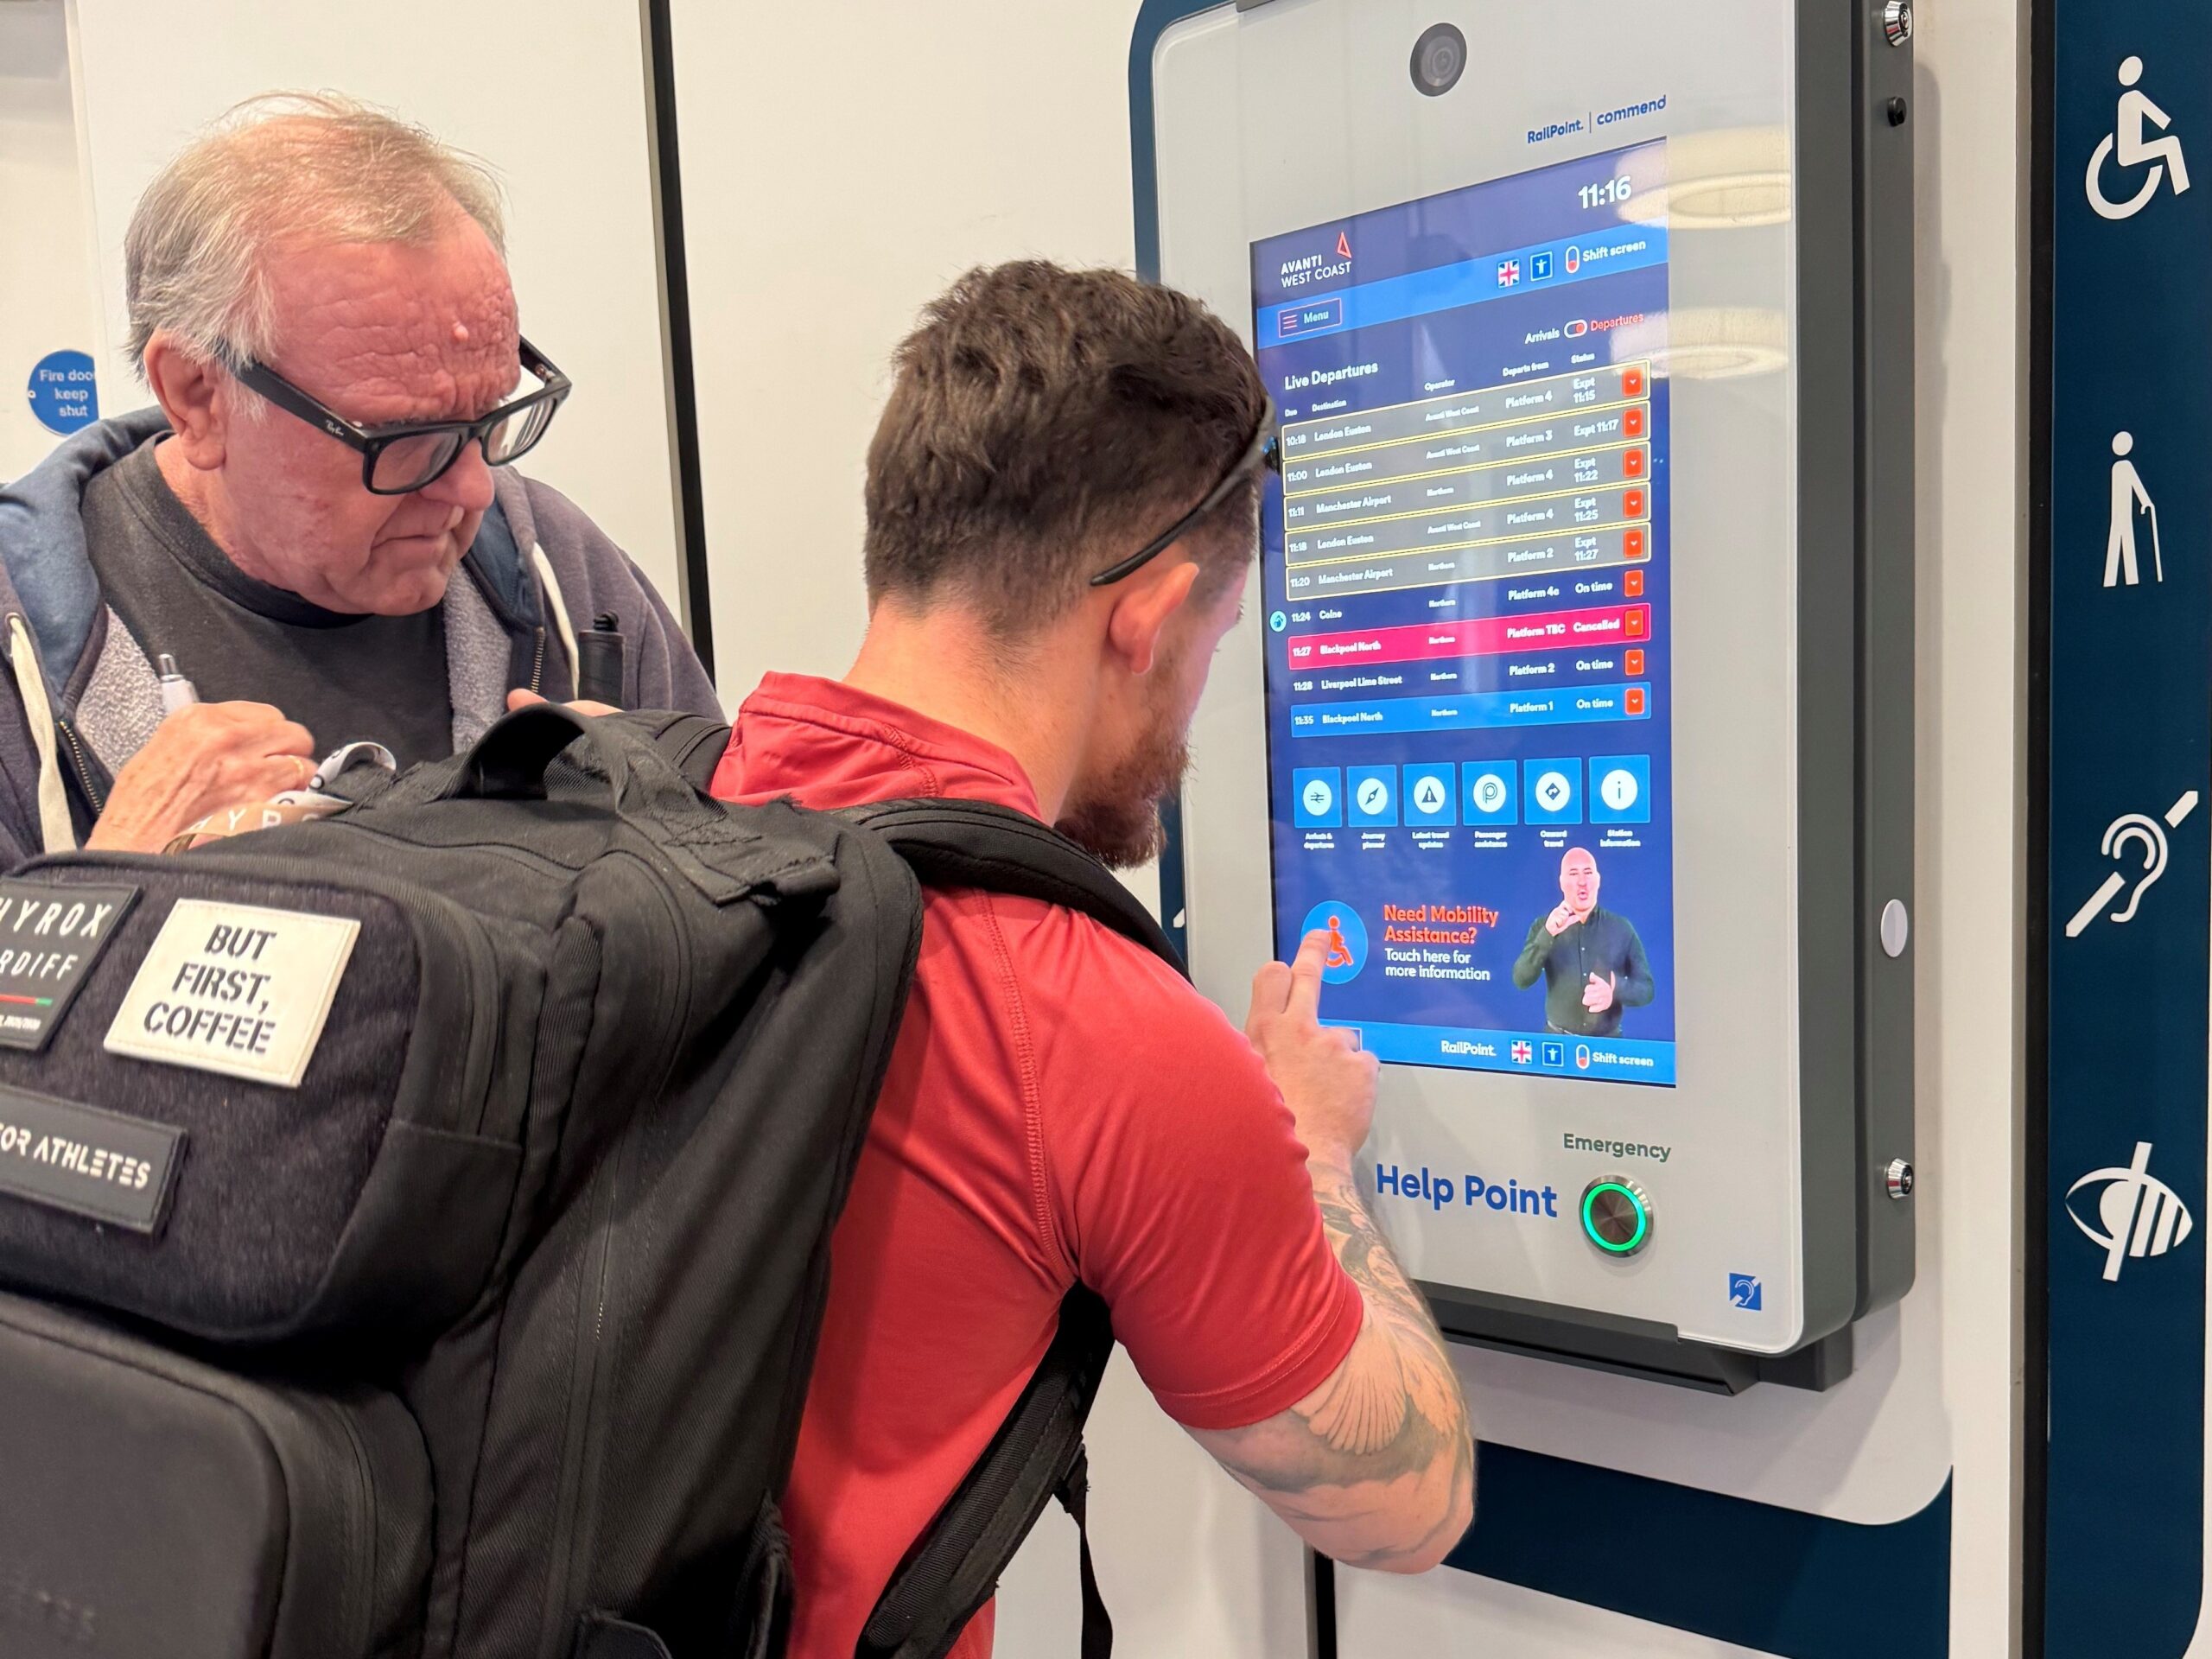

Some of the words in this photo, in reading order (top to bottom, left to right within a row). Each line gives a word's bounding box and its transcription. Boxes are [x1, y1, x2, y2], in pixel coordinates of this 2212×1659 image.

[1597, 94, 1667, 125] commend
[1578, 175, 1631, 209] 11:16
[1582, 247, 1608, 262] Shift
[1610, 240, 1646, 257] screen
[1281, 254, 1322, 275] AVANTI
[1281, 271, 1311, 288] WEST
[1314, 261, 1351, 280] COAST
[1303, 310, 1329, 324] Menu
[1591, 313, 1644, 332] Departures
[1524, 327, 1560, 345] Arrivals
[1571, 353, 1595, 364] Status
[40, 369, 65, 381] Fire
[68, 369, 94, 381] doo
[1285, 375, 1310, 391] Live
[1312, 363, 1379, 385] Departures
[1424, 379, 1455, 392] Operator
[1573, 377, 1596, 390] Expt
[54, 388, 88, 401] keep
[1505, 393, 1544, 409] Platform
[1545, 390, 1553, 402] 4
[1573, 390, 1596, 404] 11:15
[59, 404, 88, 416] shut
[1312, 399, 1347, 412] Destination
[1314, 429, 1344, 442] London
[1344, 425, 1371, 437] Euston
[1573, 424, 1597, 437] Expt
[1597, 418, 1619, 433] 11:17
[1286, 434, 1307, 447] 10:18
[1506, 433, 1545, 448] Platform
[1545, 429, 1553, 442] 3
[1315, 466, 1344, 478] London
[1345, 461, 1373, 474] Euston
[1574, 457, 1596, 470] Expt
[1287, 470, 1307, 482] 11:00
[1506, 474, 1545, 486] Platform
[1545, 469, 1554, 480] 4
[1573, 470, 1599, 483] 11:22
[1316, 499, 1362, 514] Manchester
[1363, 494, 1392, 508] Airport
[1574, 497, 1597, 510] Expt
[1288, 506, 1305, 518] 11:11
[1507, 512, 1546, 524] Platform
[1546, 508, 1554, 519] 4
[1574, 509, 1599, 523] 11:25
[1289, 541, 1307, 553] 11:18
[1317, 537, 1346, 550] London
[1347, 534, 1374, 546] Euston
[1574, 537, 1597, 550] Expt
[1507, 550, 1546, 563] Platform
[1546, 547, 1554, 558] 2
[1574, 549, 1599, 562] 11:27
[1290, 576, 1310, 588] 11:20
[1319, 571, 1363, 585] Manchester
[1363, 568, 1394, 580] Airport
[1508, 589, 1546, 601] Platform
[1575, 583, 1590, 594] On
[1591, 582, 1613, 591] time
[1291, 611, 1311, 623] 11:24
[1573, 618, 1620, 632] Cancelled
[1507, 627, 1545, 639] Platform
[1545, 623, 1566, 635] TBC
[1292, 645, 1312, 657] 11:27
[1320, 643, 1357, 656] Blackpool
[1357, 640, 1382, 652] North
[1509, 664, 1547, 676] Platform
[1547, 663, 1555, 673] 2
[1575, 660, 1591, 671] On
[1591, 659, 1613, 669] time
[1321, 677, 1357, 690] Liverpool
[1357, 677, 1377, 687] Lime
[1377, 675, 1402, 685] Street
[1510, 702, 1548, 713] Platform
[1548, 701, 1554, 711] 1
[1576, 698, 1591, 709] On
[1591, 698, 1613, 708] time
[1294, 715, 1314, 726] 11:35
[1322, 713, 1360, 725] Blackpool
[1360, 711, 1383, 721] North
[1383, 904, 1427, 923] Need
[1430, 906, 1499, 928] Mobility
[204, 923, 277, 962] BUT
[1384, 925, 1478, 944] Assistance?
[1384, 947, 1422, 963] Touch
[1423, 949, 1452, 963] here
[1452, 950, 1471, 964] for
[1385, 966, 1417, 978] more
[1419, 964, 1491, 981] information
[172, 962, 271, 1013] FIRST,
[143, 1001, 276, 1055] COFFEE
[1440, 1039, 1497, 1057] RailPoint.
[1592, 1051, 1618, 1065] Shift
[1618, 1055, 1655, 1067] screen
[0, 1122, 31, 1157] OR
[33, 1135, 151, 1189] ATHLETES
[1563, 1132, 1671, 1163] Emergency
[1376, 1163, 1454, 1211] Help
[1465, 1175, 1558, 1217] Point
